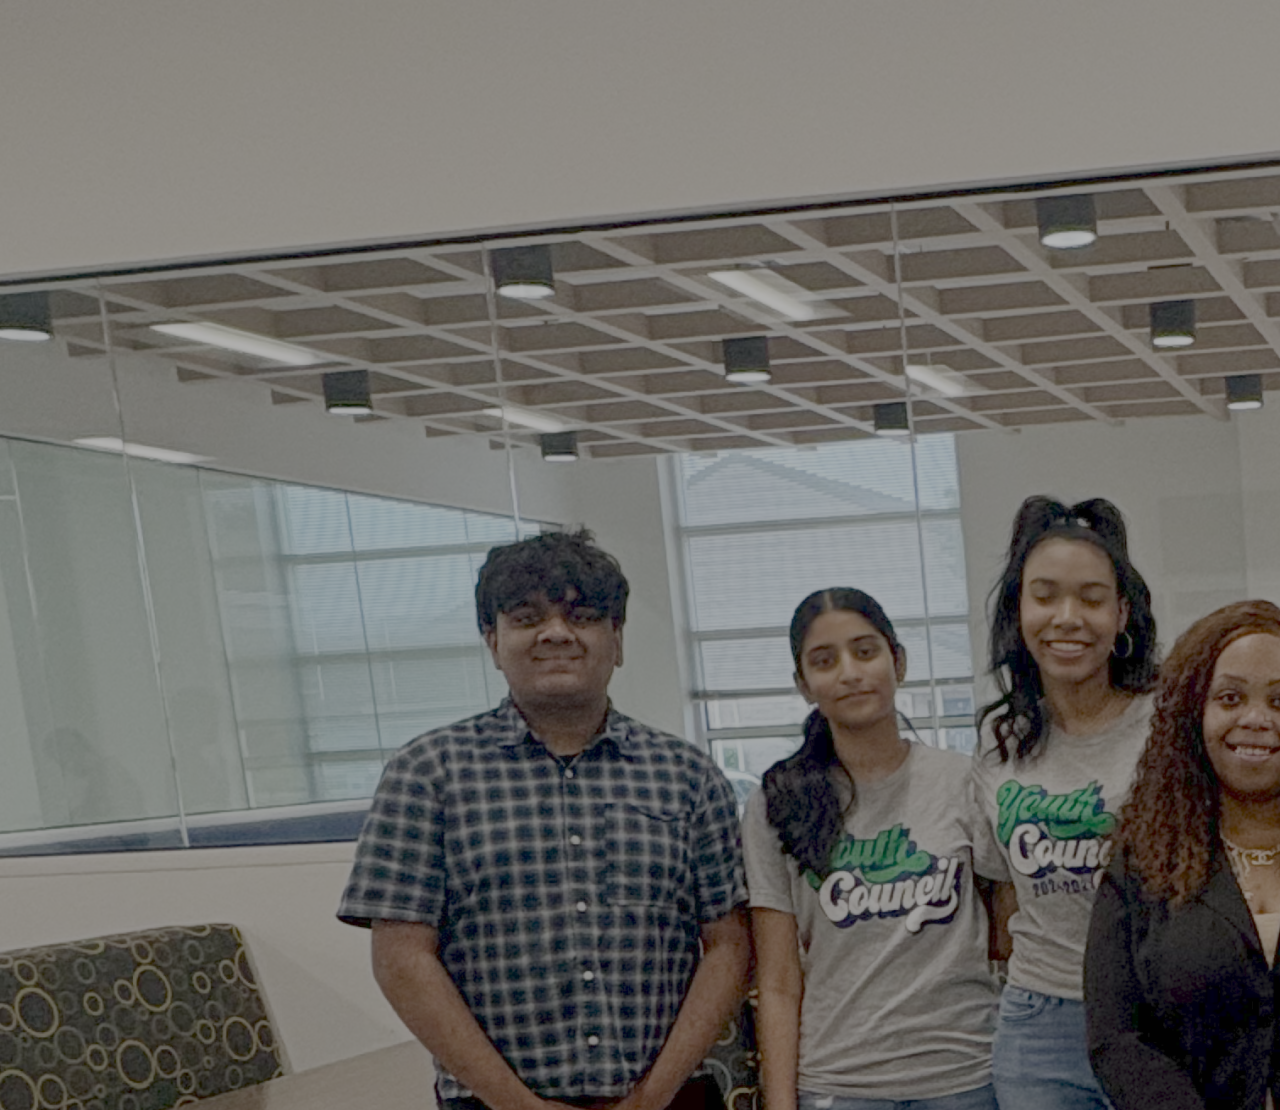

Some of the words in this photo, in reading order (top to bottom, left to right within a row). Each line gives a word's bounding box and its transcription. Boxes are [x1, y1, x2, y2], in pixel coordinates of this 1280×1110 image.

[997, 779, 1119, 850] Youth
[818, 822, 937, 886] outh
[819, 855, 965, 935] Council
